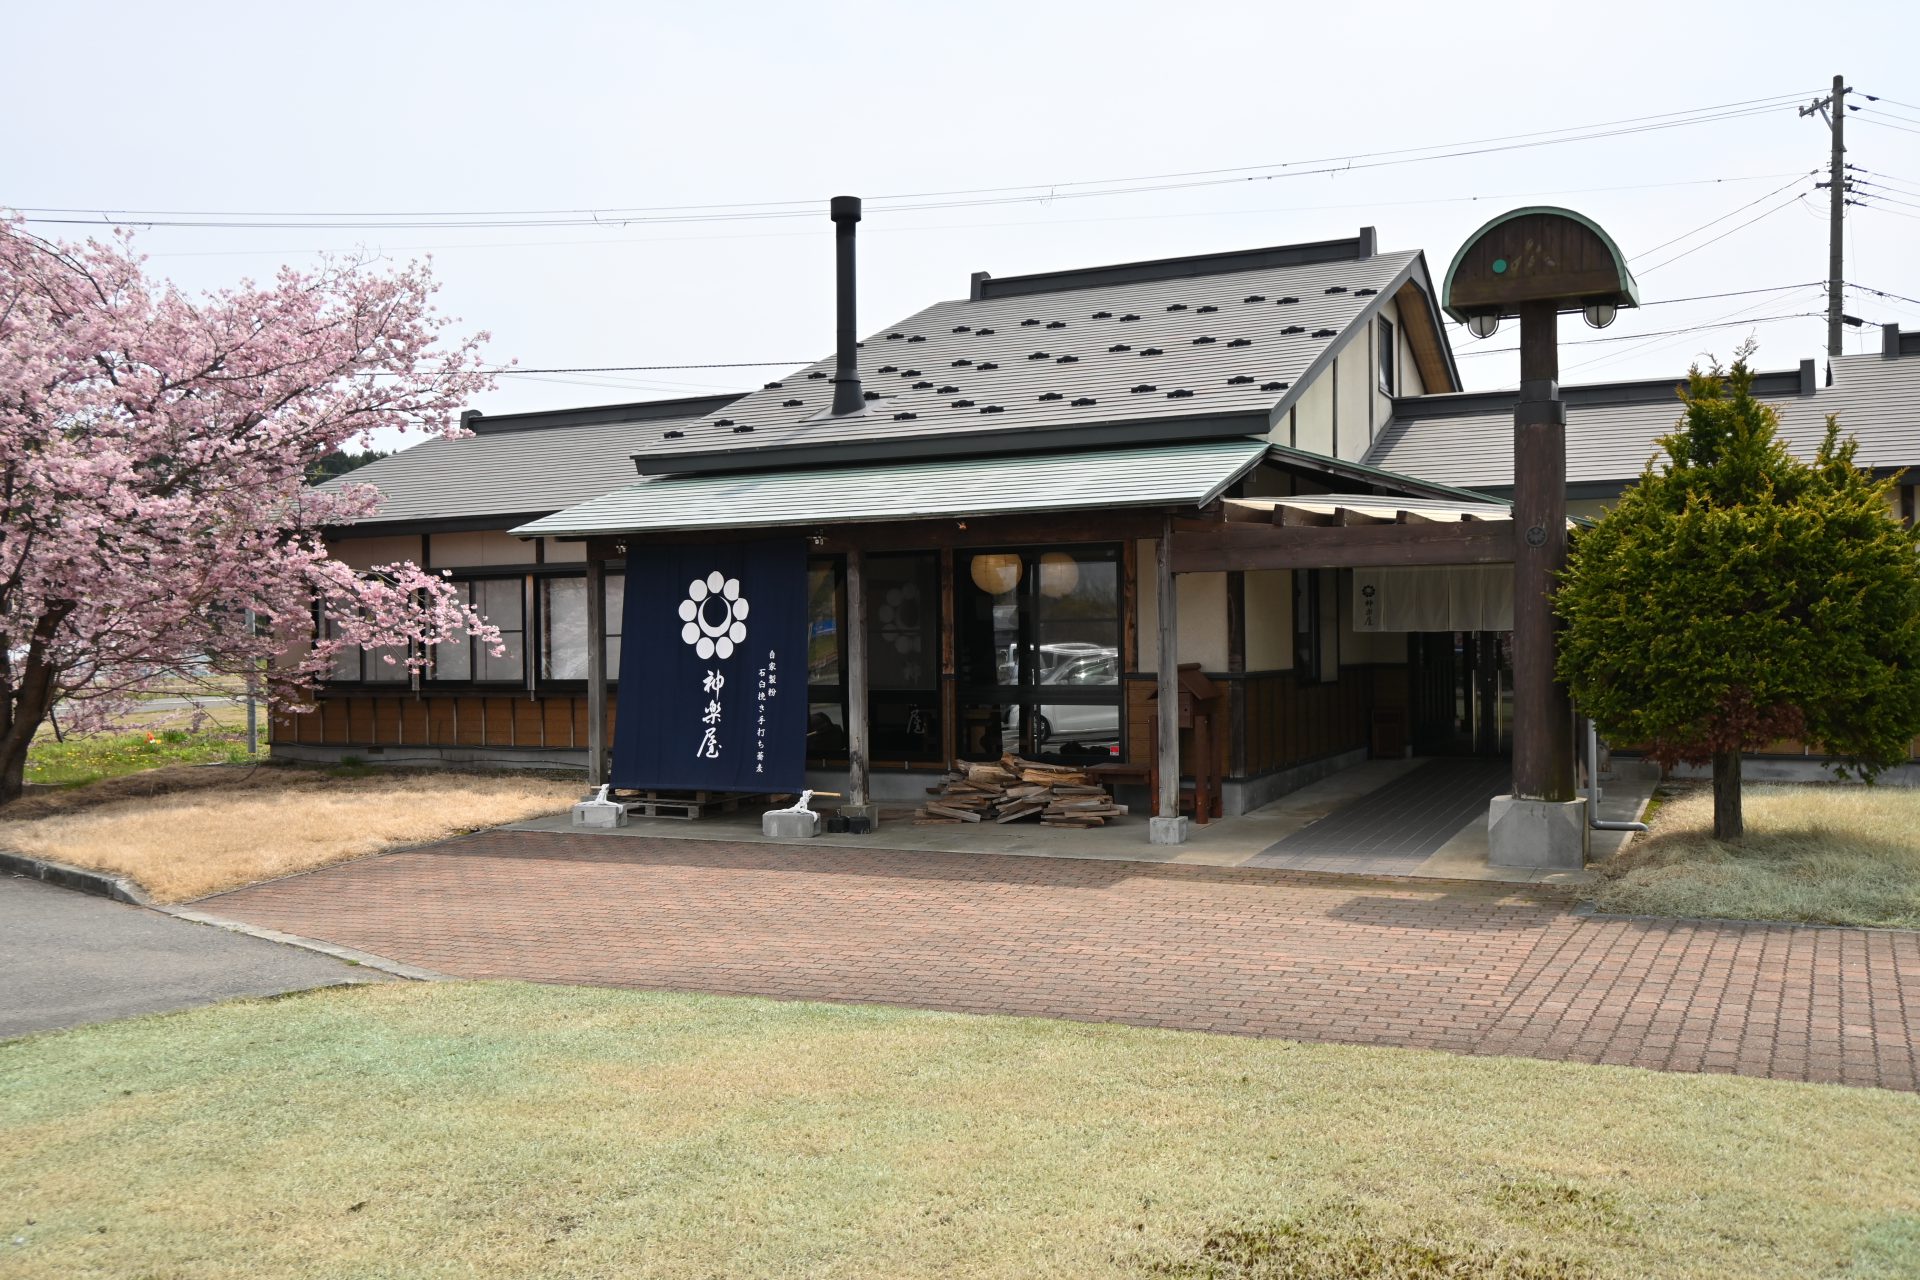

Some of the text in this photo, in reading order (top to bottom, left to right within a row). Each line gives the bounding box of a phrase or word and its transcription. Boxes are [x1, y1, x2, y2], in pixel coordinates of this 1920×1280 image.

[767, 649, 777, 697] 自家製粉
[696, 668, 725, 759] 神楽屋
